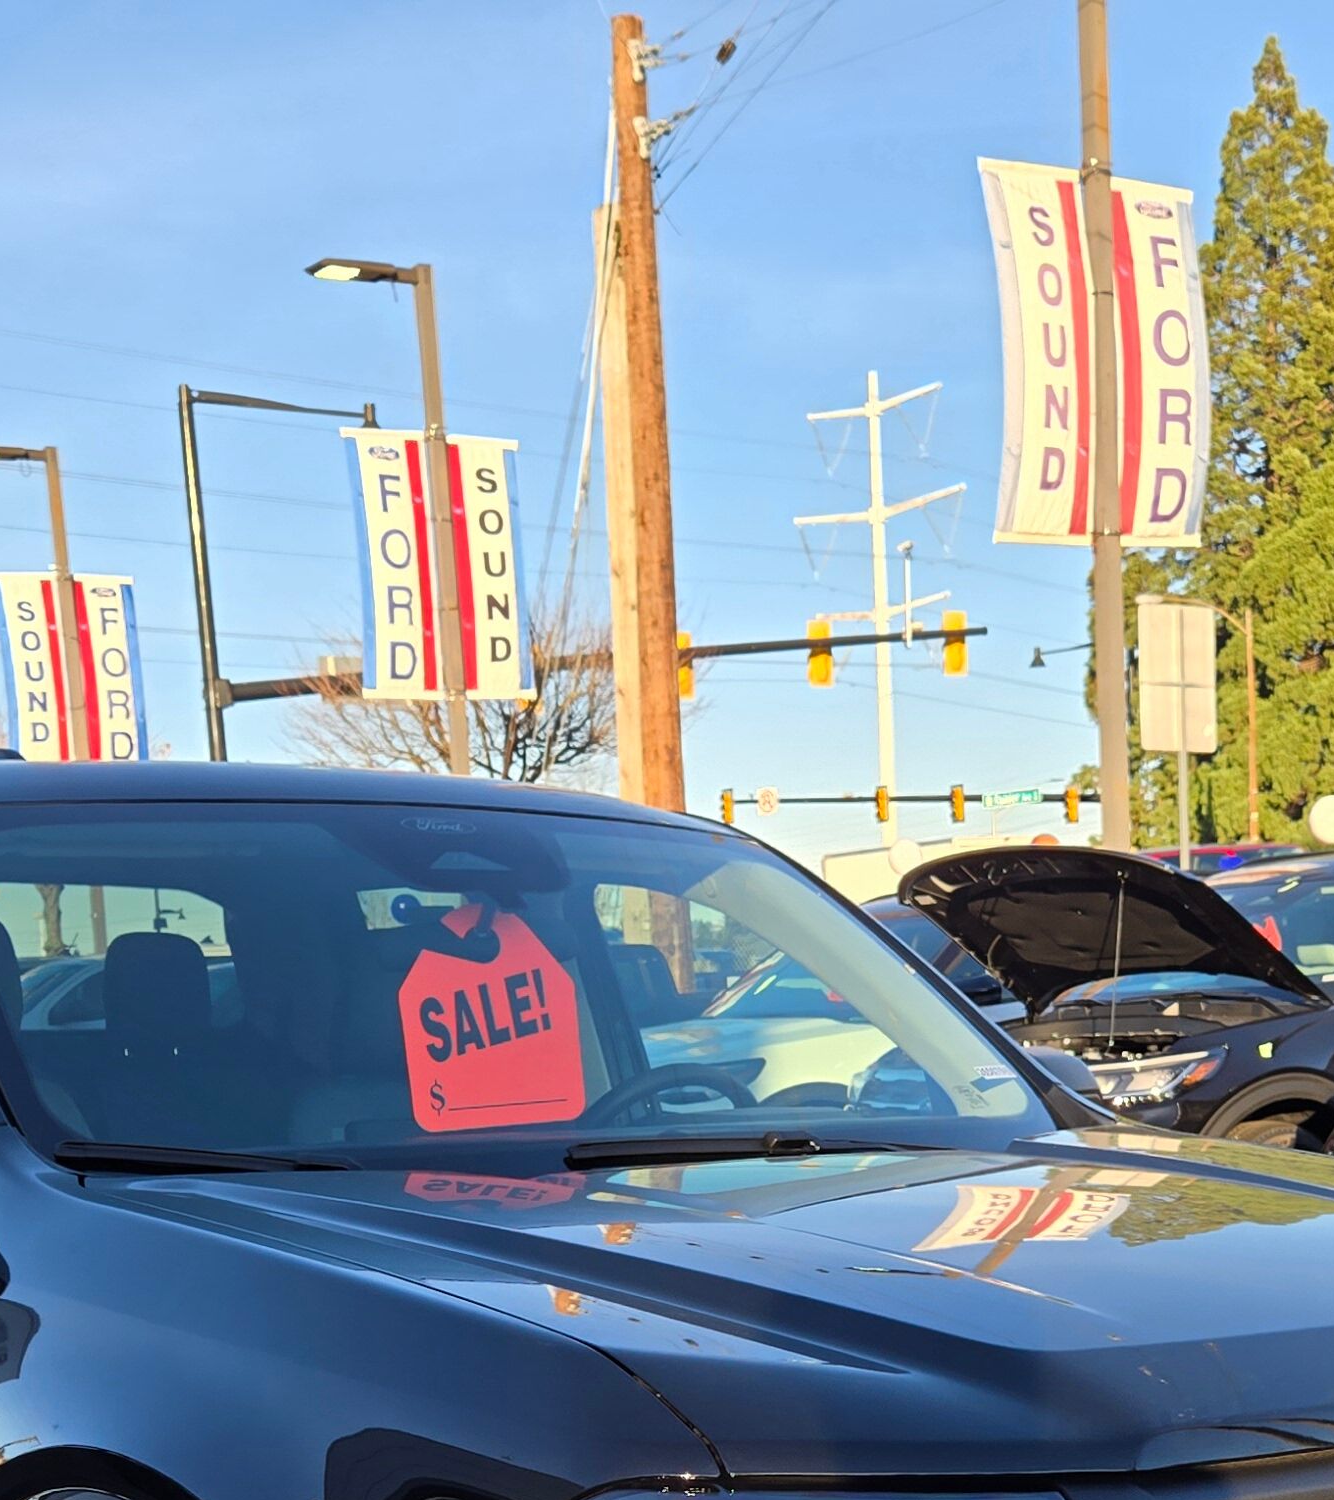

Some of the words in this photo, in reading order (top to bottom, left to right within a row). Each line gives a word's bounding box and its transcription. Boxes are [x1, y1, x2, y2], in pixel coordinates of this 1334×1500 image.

[1029, 205, 1069, 491] SOUND
[1149, 235, 1193, 523] FORD
[378, 473, 417, 680] FORD
[475, 467, 512, 663] SOUND
[17, 600, 50, 743] SOUND
[100, 607, 135, 760] FORD
[419, 968, 552, 1063] SALE!
[429, 1079, 446, 1117] $
